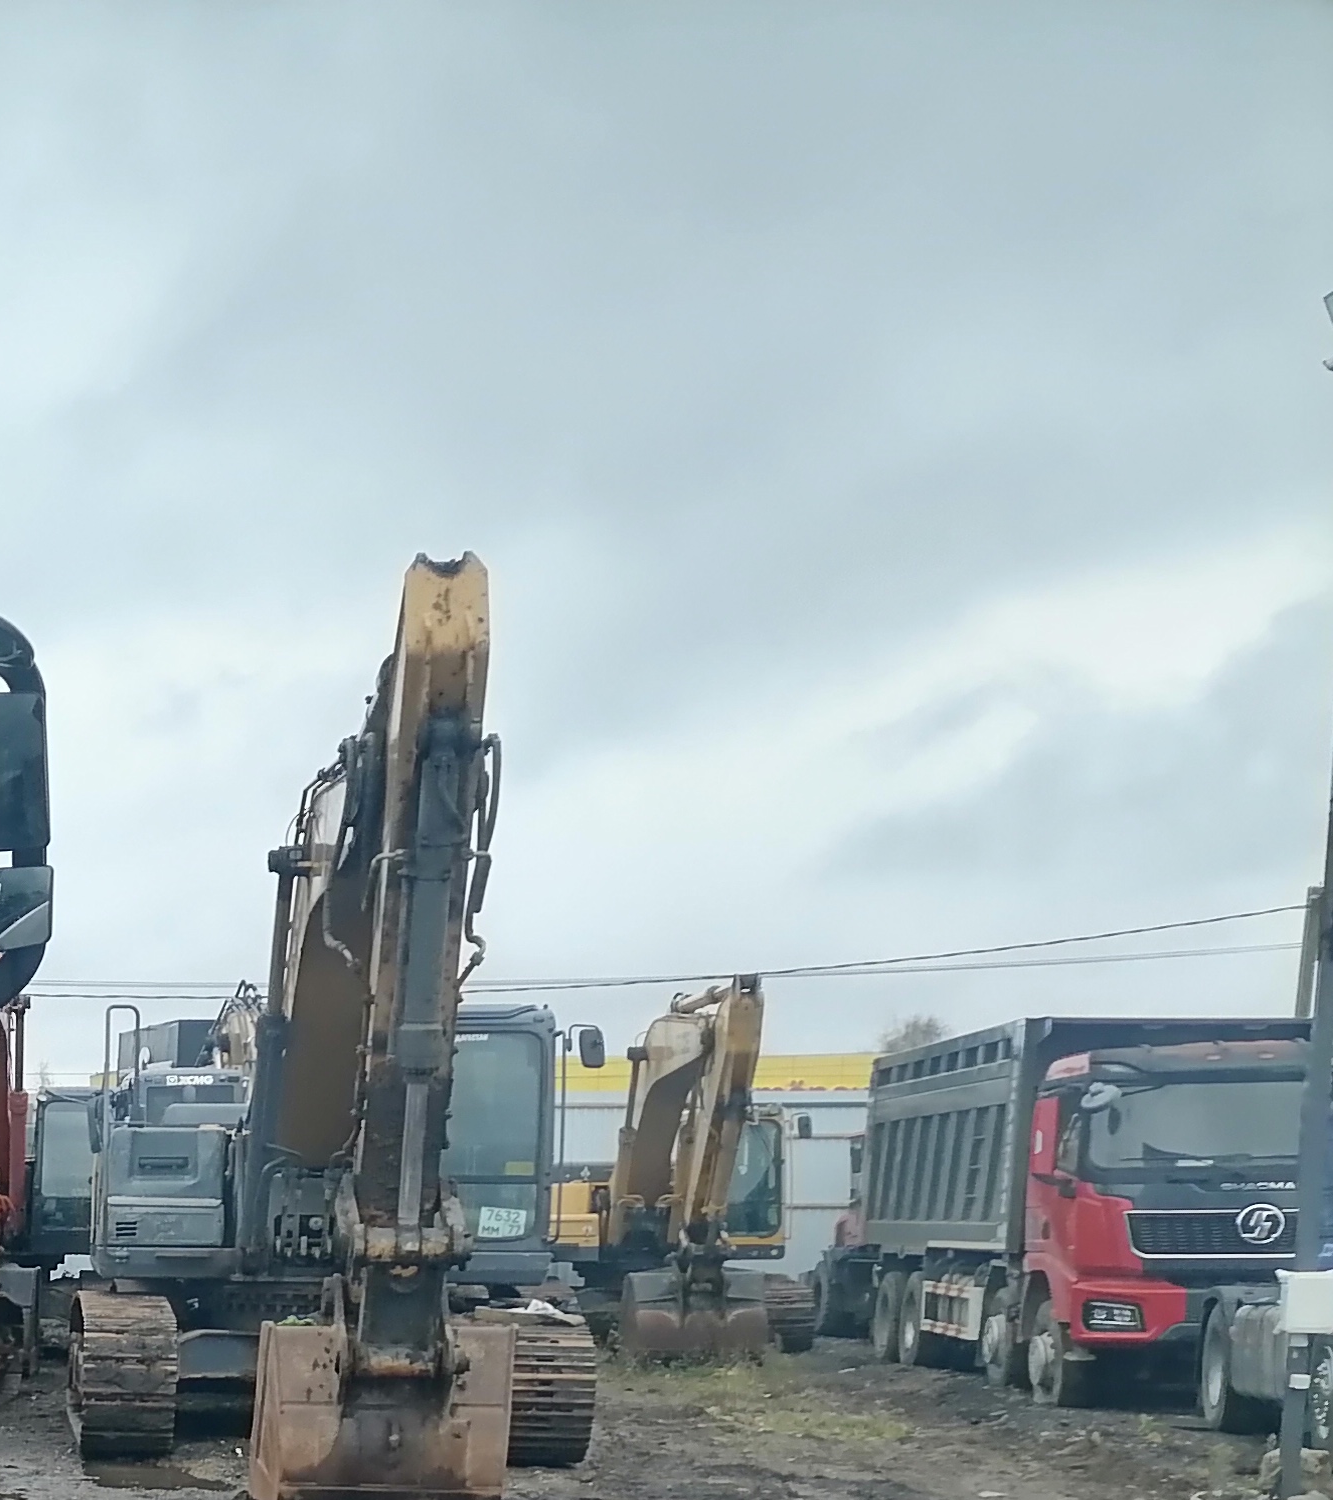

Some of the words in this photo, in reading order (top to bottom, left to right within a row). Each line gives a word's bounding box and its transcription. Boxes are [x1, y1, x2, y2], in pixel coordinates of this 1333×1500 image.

[177, 1075, 214, 1085] XCMG
[1220, 1181, 1296, 1190] SHACMA
[486, 1209, 521, 1223] 7632
[507, 1224, 521, 1235] 77
